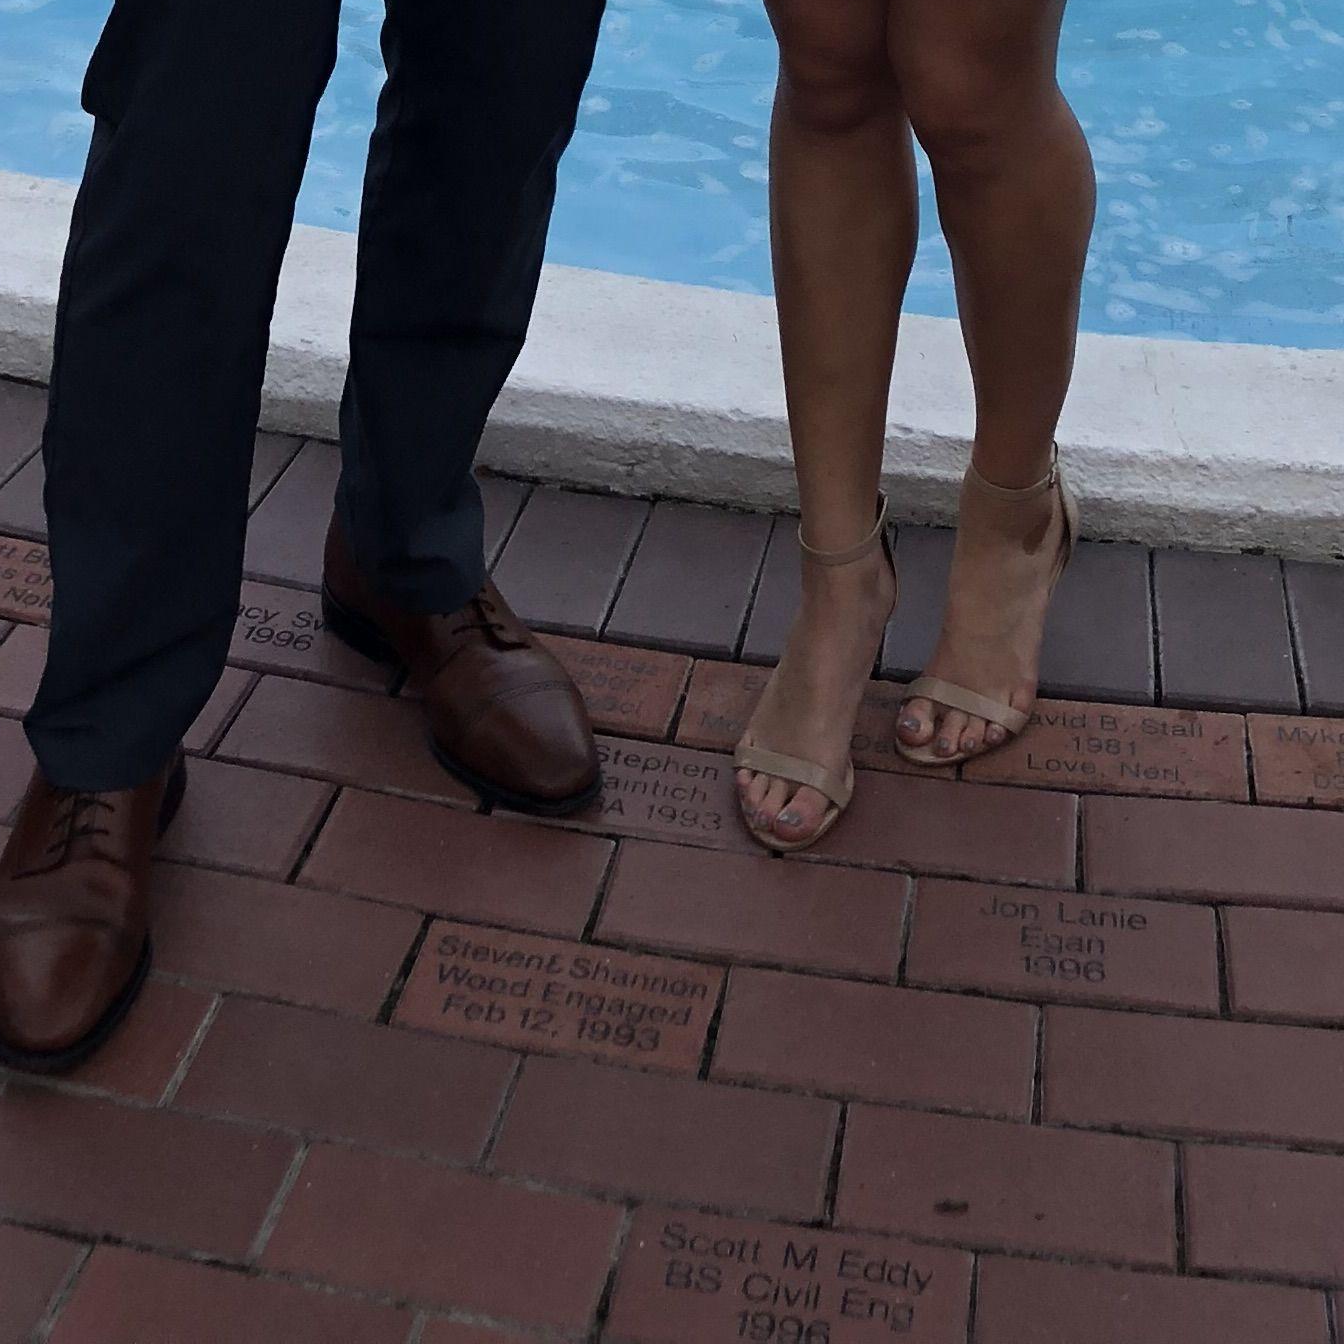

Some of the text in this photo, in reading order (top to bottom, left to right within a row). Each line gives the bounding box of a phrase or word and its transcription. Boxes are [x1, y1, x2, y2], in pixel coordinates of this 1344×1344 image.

[4, 585, 51, 609] Nol
[244, 624, 314, 651] 1996
[1026, 710, 1087, 729] avid
[594, 744, 720, 781] Stephen
[1071, 736, 1137, 757] 1981
[648, 804, 722, 831] 1993
[979, 895, 1148, 931] Jon Lanie
[1021, 925, 1106, 955] Egan
[569, 957, 709, 1000] Shannon
[1022, 955, 1106, 983] 1996
[437, 963, 692, 1026] Wood Engaged
[442, 993, 507, 1024] Feb
[576, 1017, 661, 1052] 1993
[660, 1221, 934, 1296] Scott M Eddy
[664, 1258, 915, 1333] BS Civil Eng
